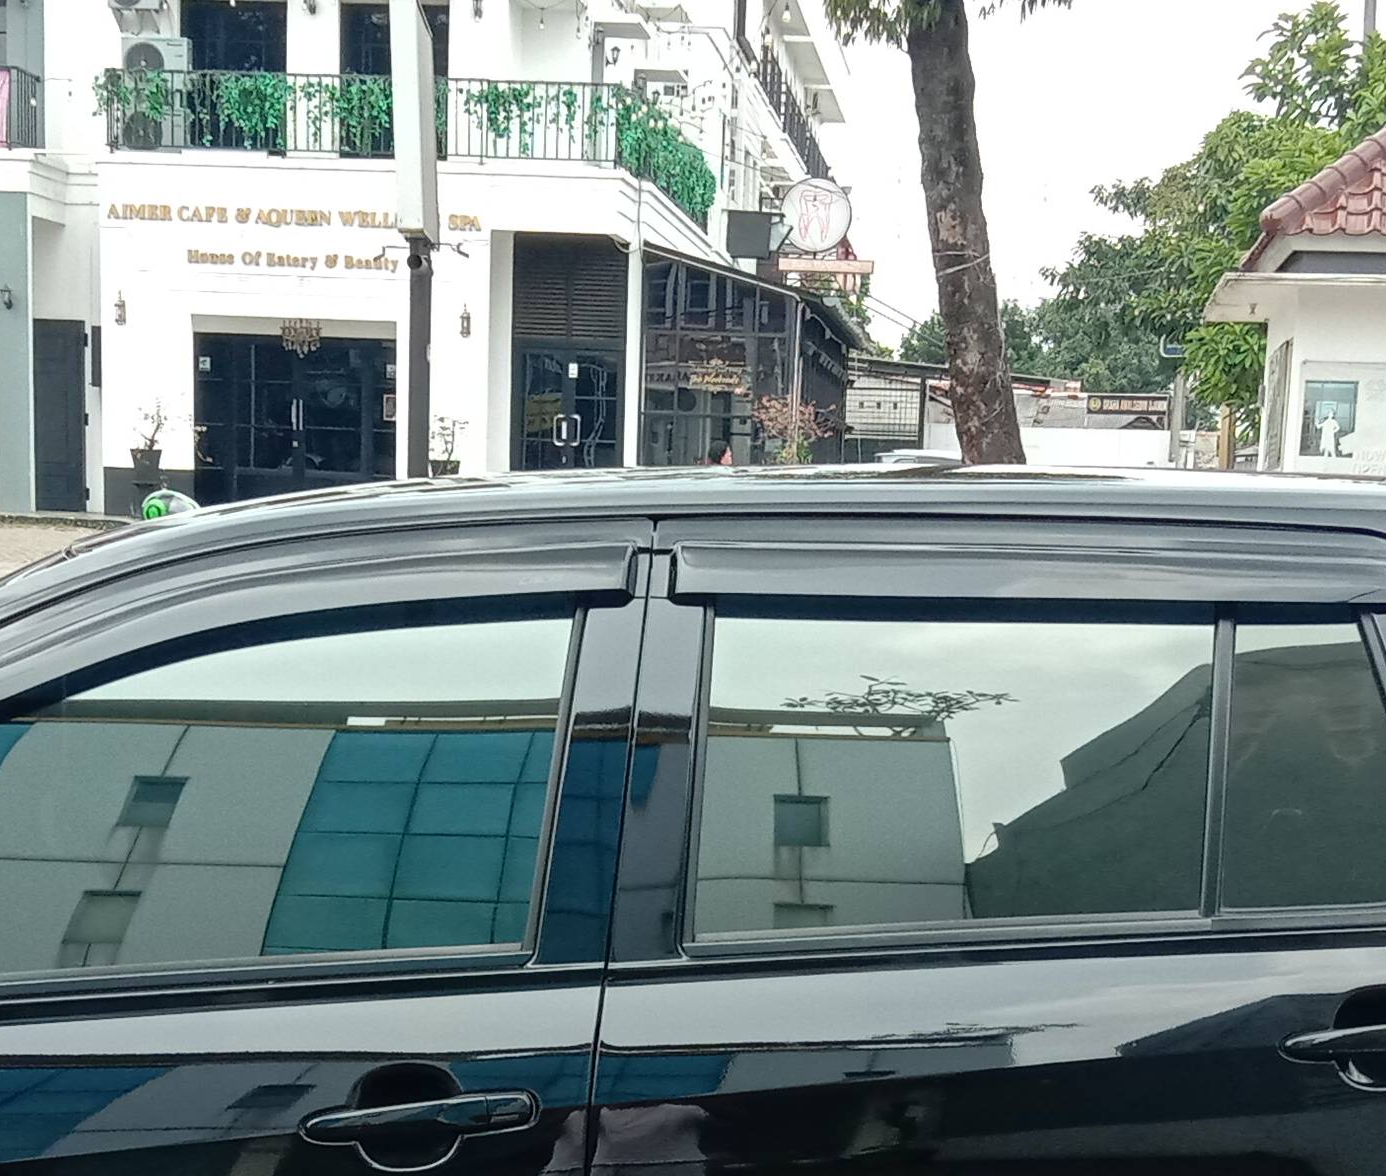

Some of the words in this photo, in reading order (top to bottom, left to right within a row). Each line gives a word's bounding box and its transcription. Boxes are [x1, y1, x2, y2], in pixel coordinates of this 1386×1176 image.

[107, 203, 173, 221] AIMER
[176, 205, 228, 223] CAFE
[235, 206, 251, 224] &
[447, 213, 482, 232] SPA
[187, 249, 235, 265] House
[240, 251, 262, 266] Of
[266, 252, 317, 271] Eatery
[324, 253, 338, 269] &
[344, 255, 399, 273] Beauty
